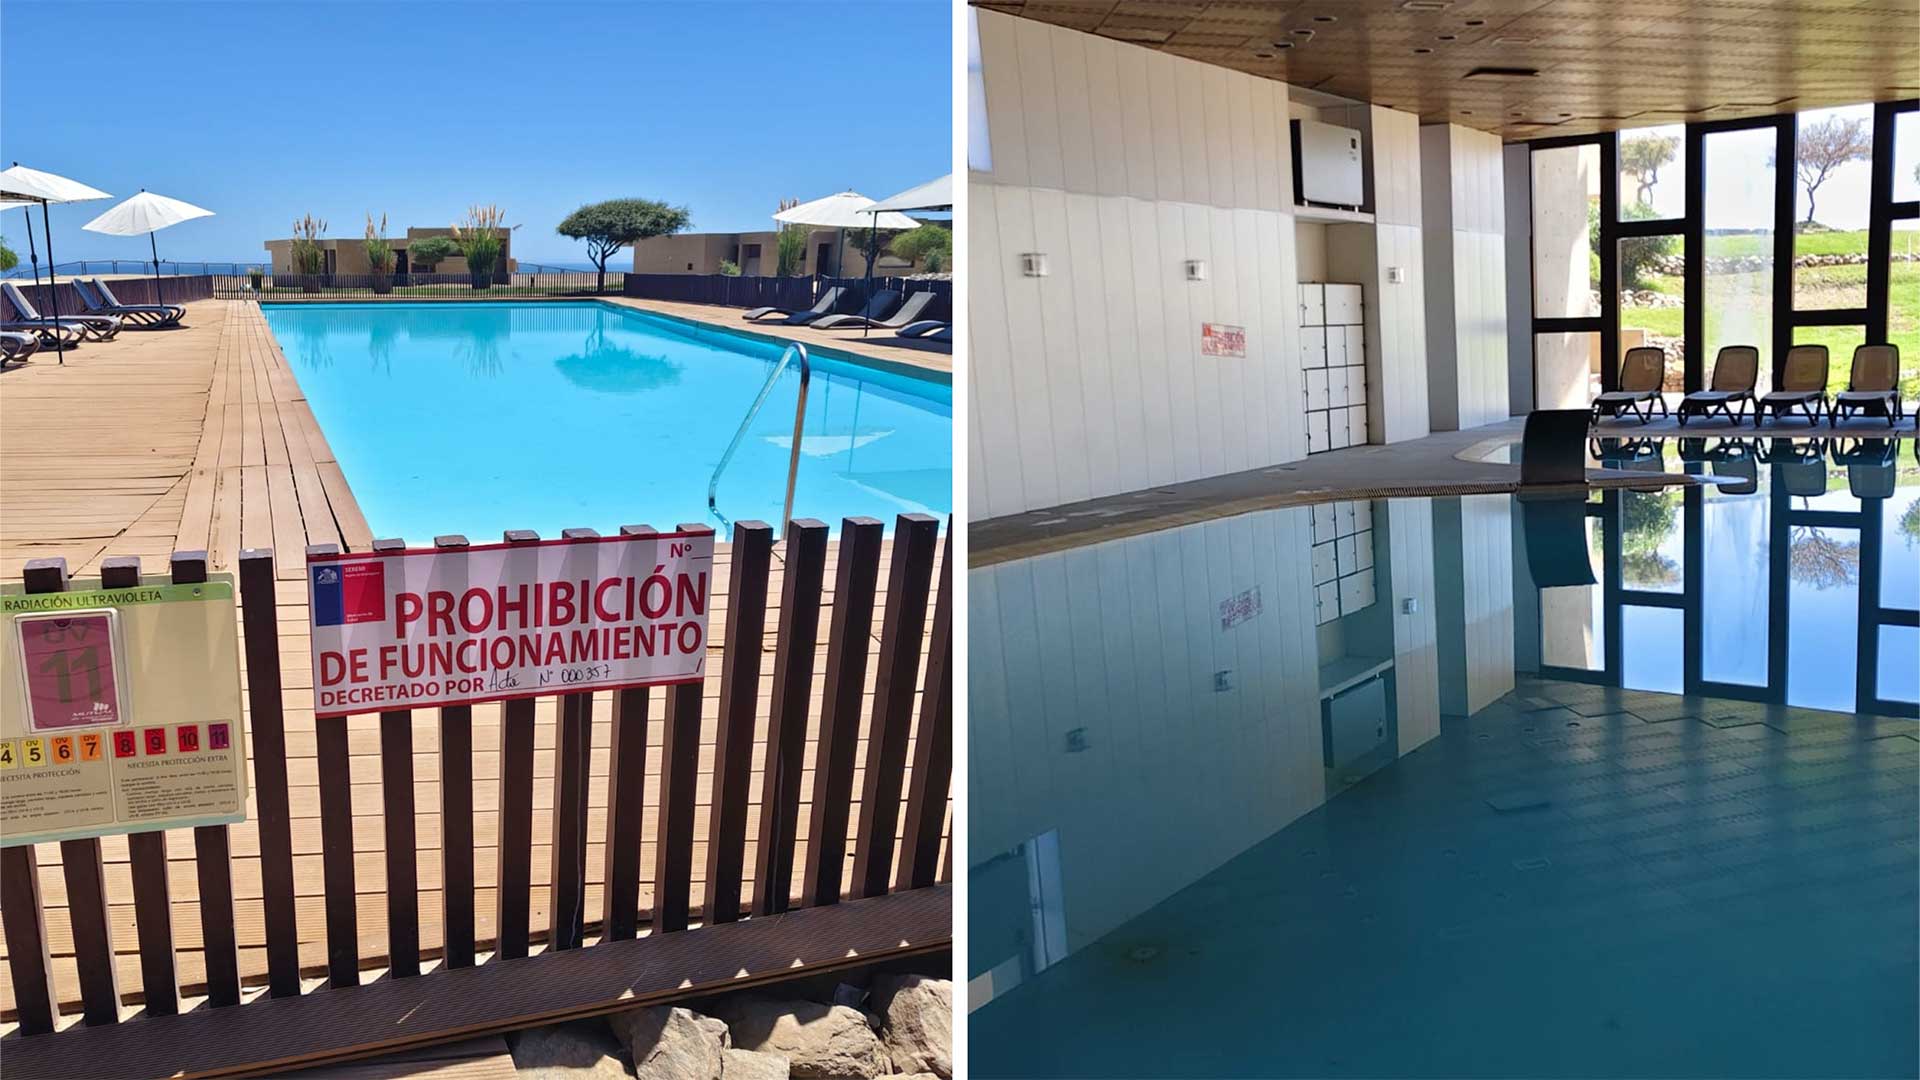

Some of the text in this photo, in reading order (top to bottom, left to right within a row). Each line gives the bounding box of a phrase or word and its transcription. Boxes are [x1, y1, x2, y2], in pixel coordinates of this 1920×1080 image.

[4, 590, 163, 611] RADIACIÓN ULTRAVIOLETA
[395, 565, 707, 639] PROHIBICIÓN
[320, 621, 703, 687] DE FUNCIONAMIENTO
[39, 646, 102, 704] 11
[320, 677, 484, 707] DECRETADO POR
[0, 730, 226, 764] 4 5 6 7 8 9 10 11
[127, 755, 229, 769] NECESITA PROTECCIÓN EXTRA
[33, 768, 81, 780] PROTECCIÓN
